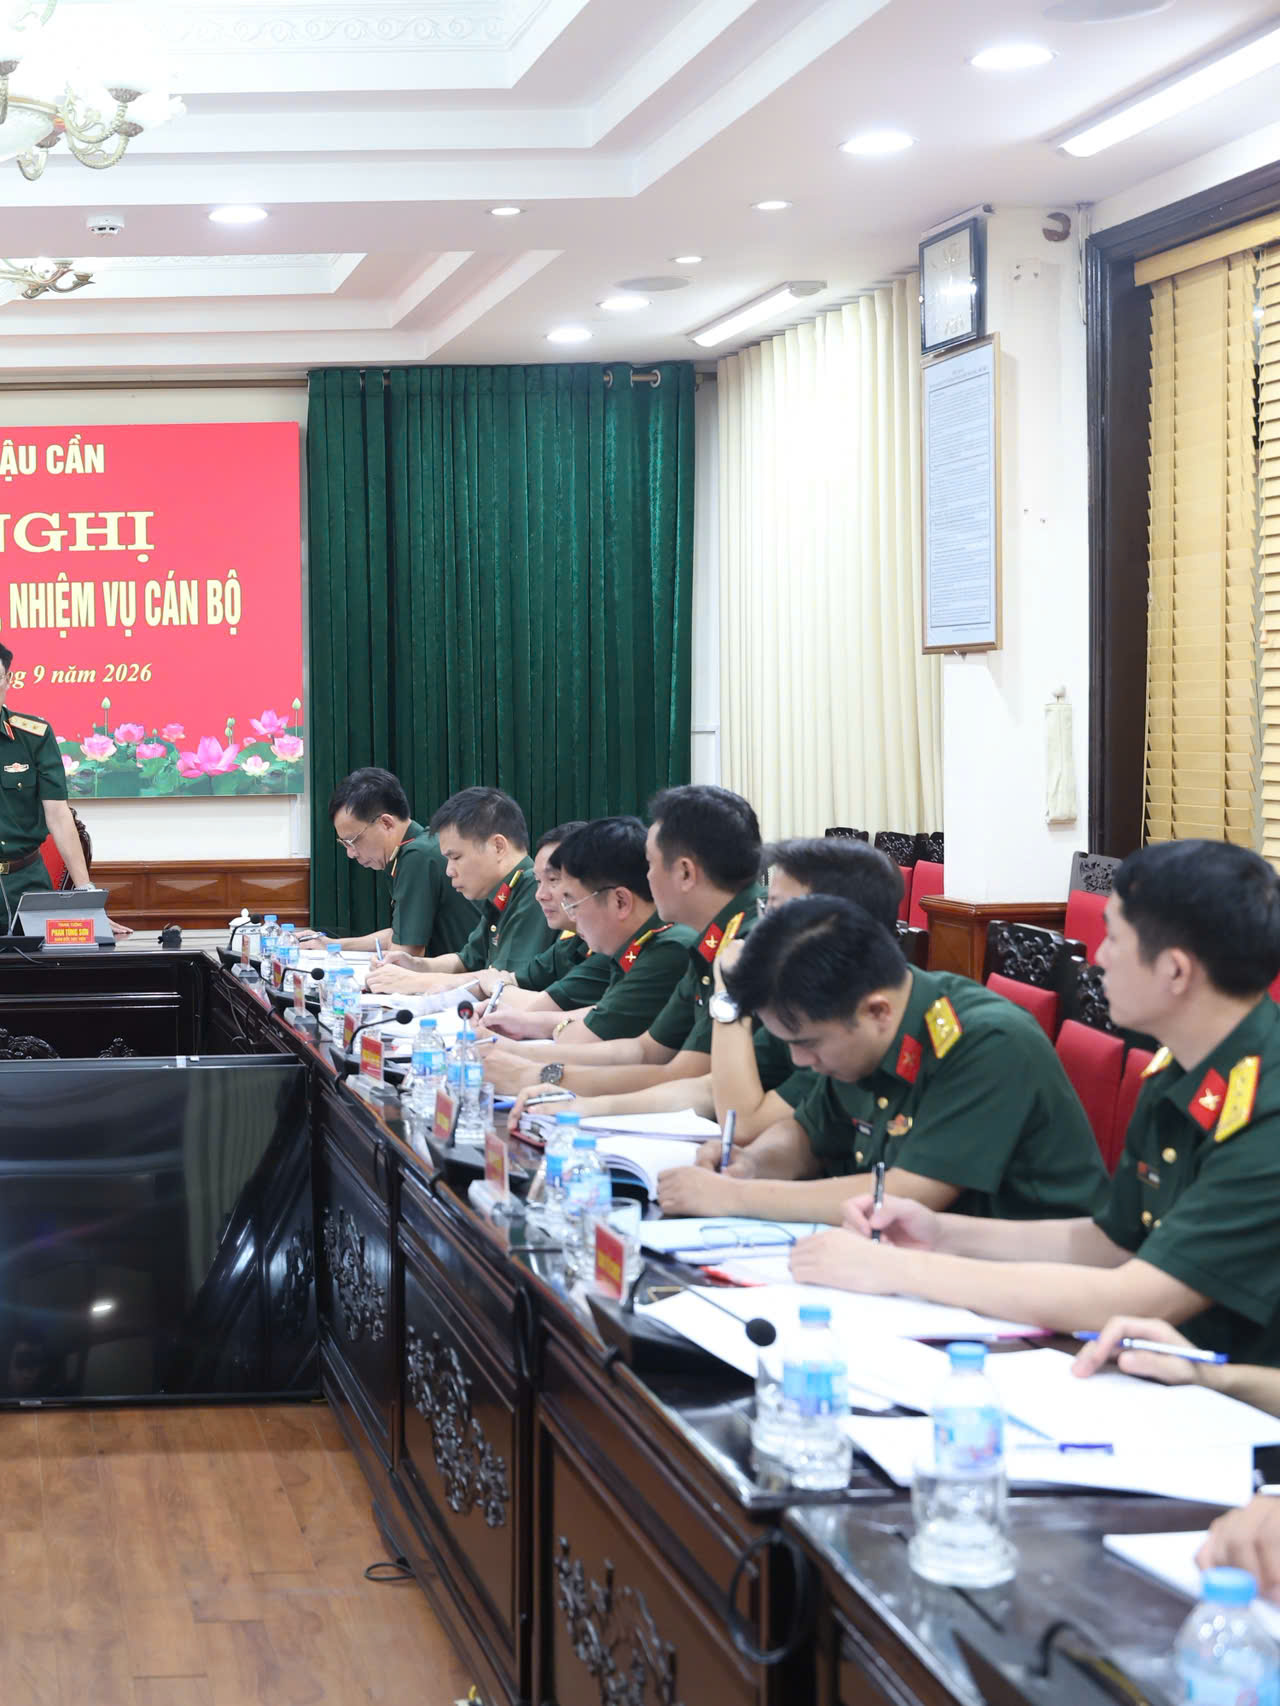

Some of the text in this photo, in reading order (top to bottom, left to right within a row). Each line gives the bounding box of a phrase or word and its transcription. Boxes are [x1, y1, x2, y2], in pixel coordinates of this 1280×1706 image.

[45, 433, 105, 475] CẦN
[9, 571, 96, 639] NHIỆM
[101, 580, 137, 638] VỤ
[144, 569, 199, 627] CÁN
[206, 568, 242, 636] BỘ
[34, 664, 46, 684] 9
[51, 662, 97, 684] năm
[102, 662, 153, 683] 2026
